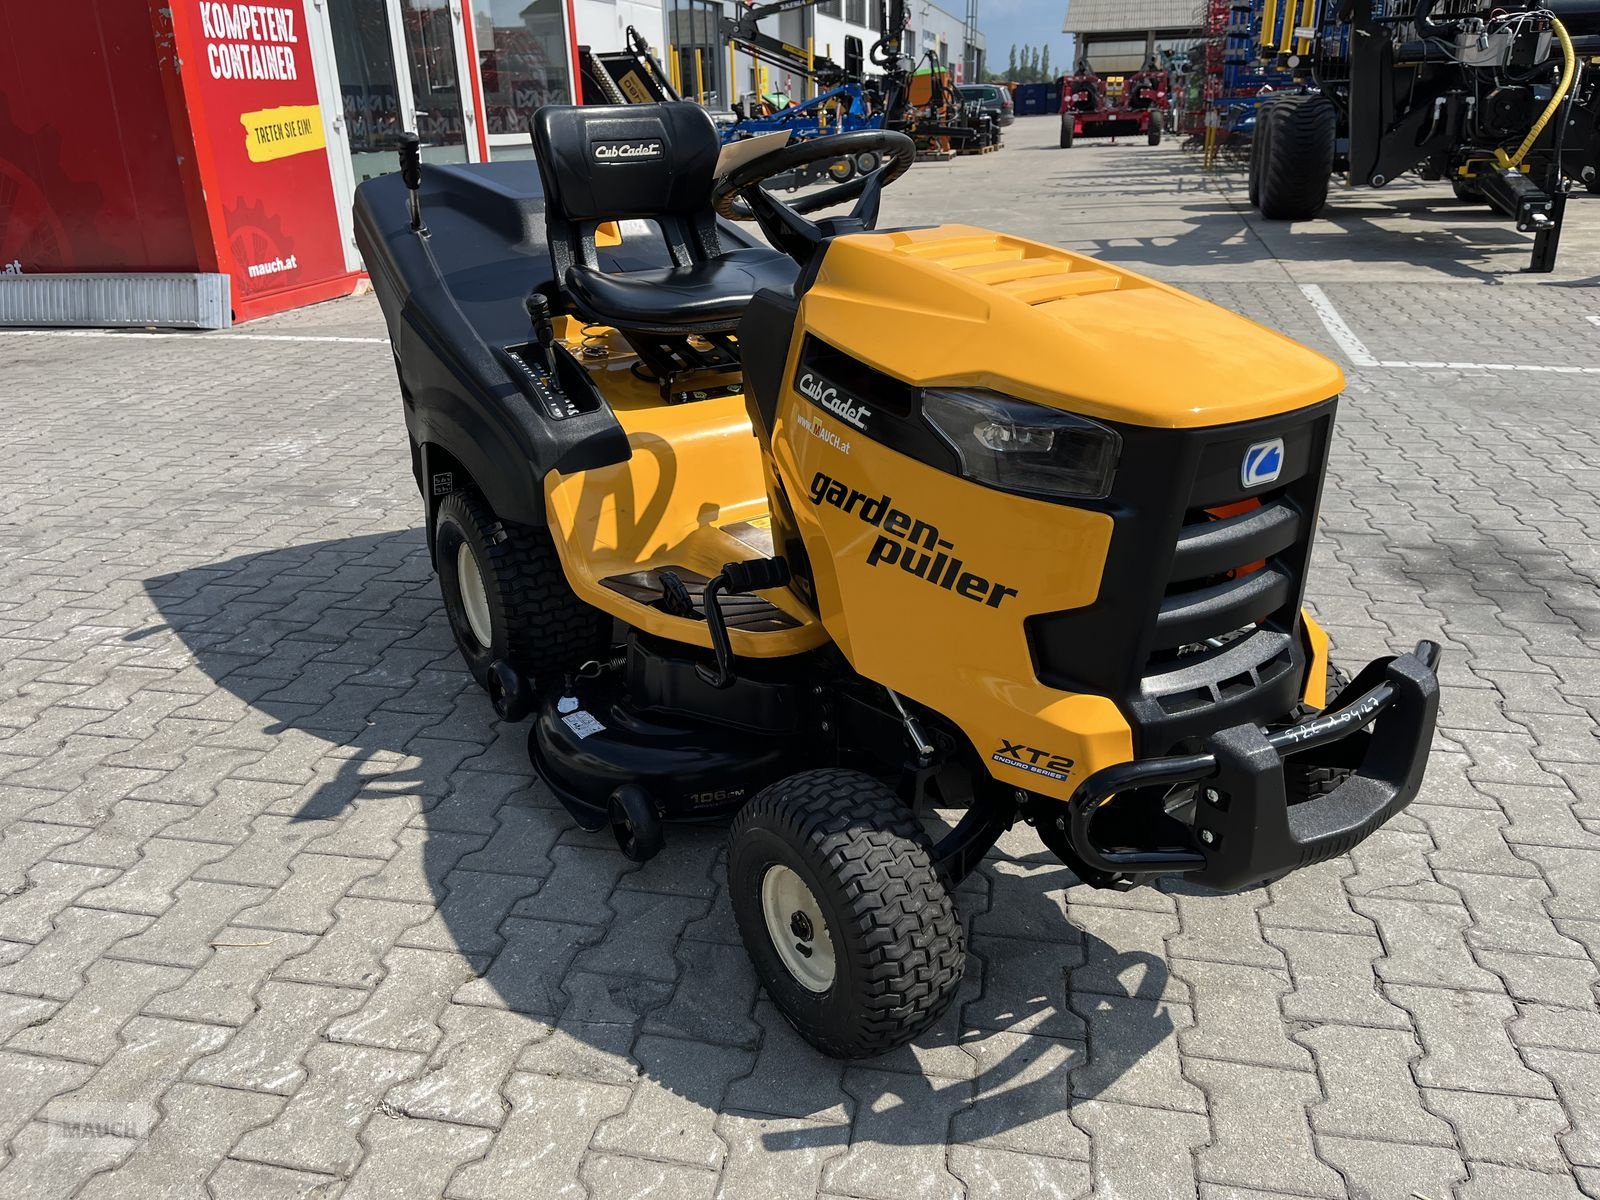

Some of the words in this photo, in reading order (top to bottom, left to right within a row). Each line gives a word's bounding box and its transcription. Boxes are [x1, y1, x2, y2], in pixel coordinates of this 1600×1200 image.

[200, 2, 298, 43] KOMPETENZ
[208, 43, 297, 81] CONTAINER
[254, 124, 285, 144] TRETEN
[284, 121, 297, 139] SIE
[297, 118, 312, 137] EIN!
[595, 145, 618, 158] Cub
[619, 143, 660, 157] Cadet
[248, 254, 297, 278] mauch.at
[799, 373, 823, 401] Cub
[821, 387, 872, 430] Cadet
[810, 471, 955, 551] garden-
[866, 534, 1018, 609] puller
[993, 755, 1029, 770] ENDURO
[1030, 766, 1063, 780] SERIES
[995, 738, 1075, 774] XT2
